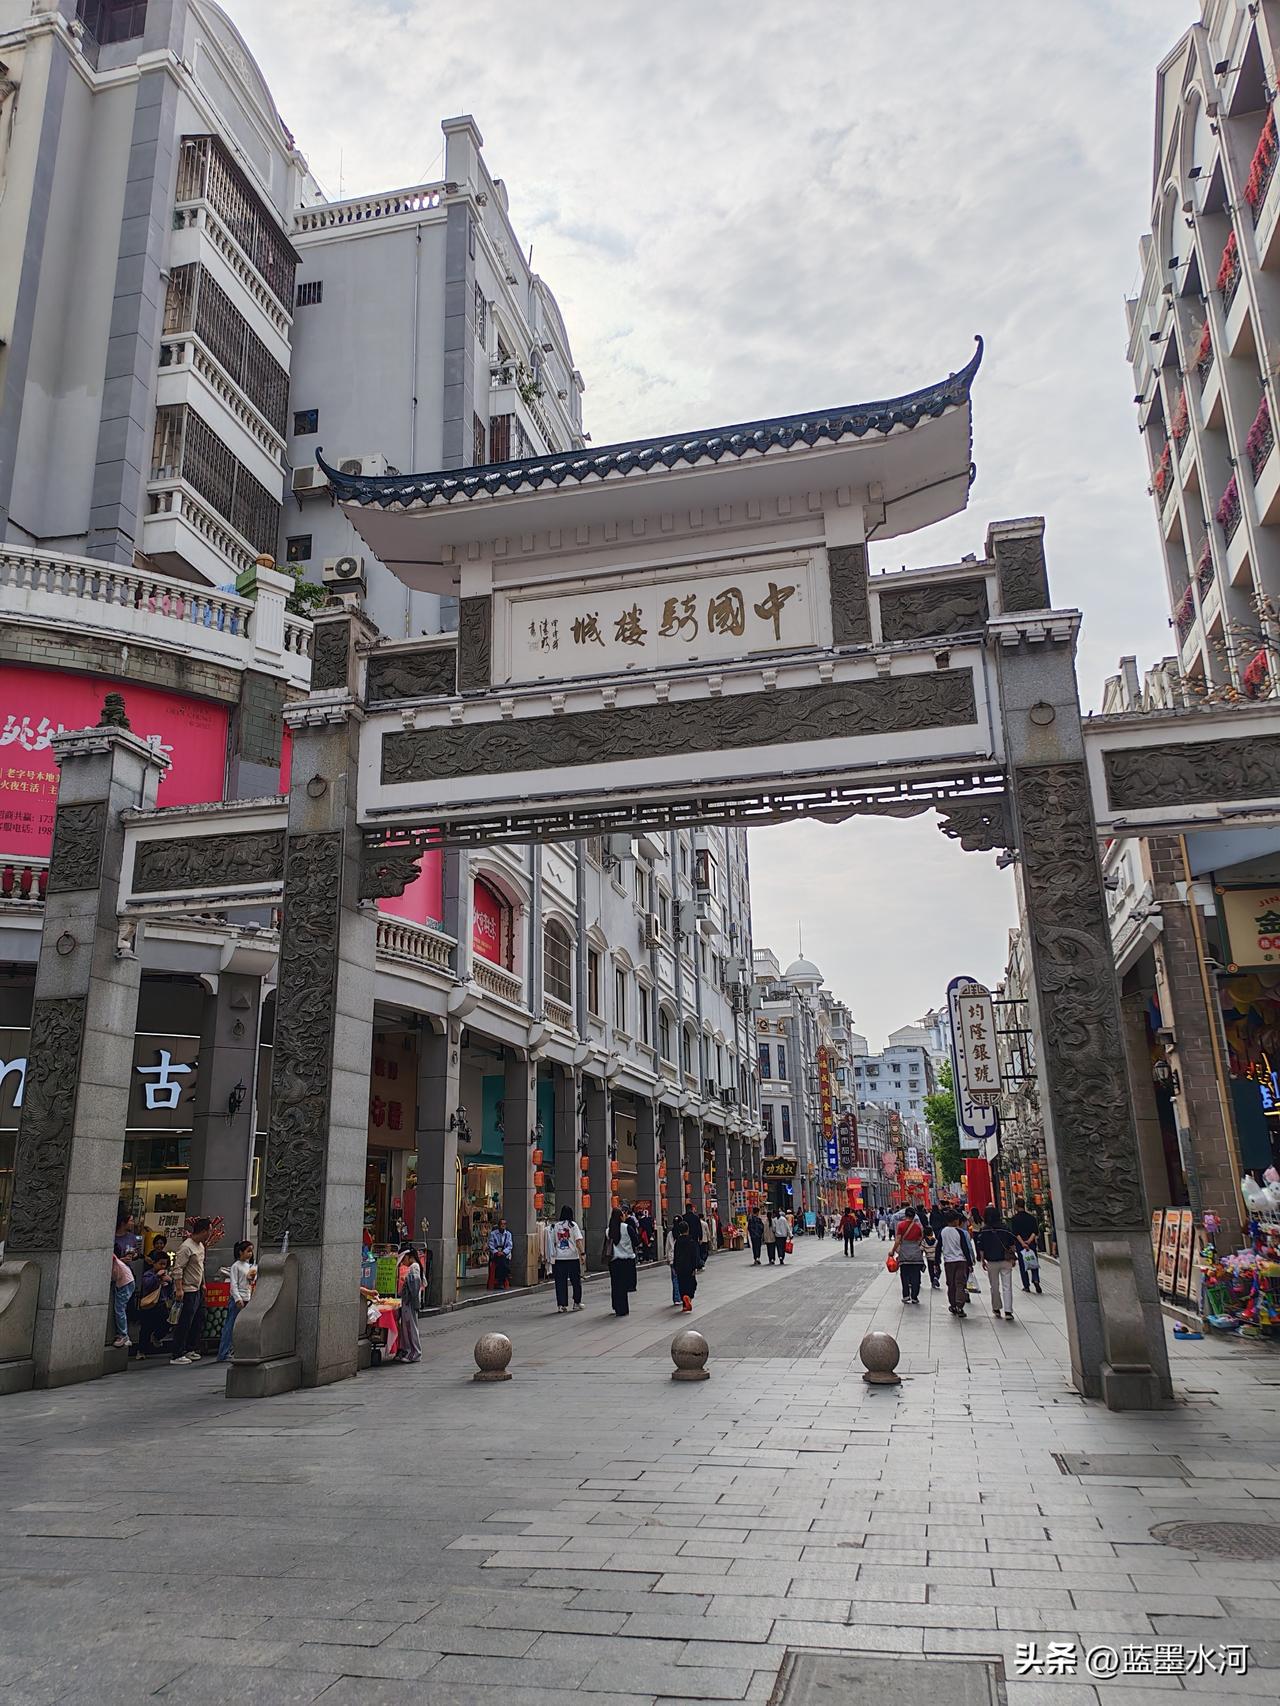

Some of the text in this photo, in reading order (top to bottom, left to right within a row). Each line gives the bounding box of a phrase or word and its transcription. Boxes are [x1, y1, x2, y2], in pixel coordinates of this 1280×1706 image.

[968, 1003, 994, 1083] 均隆銀號
[136, 1049, 192, 1110] 古
